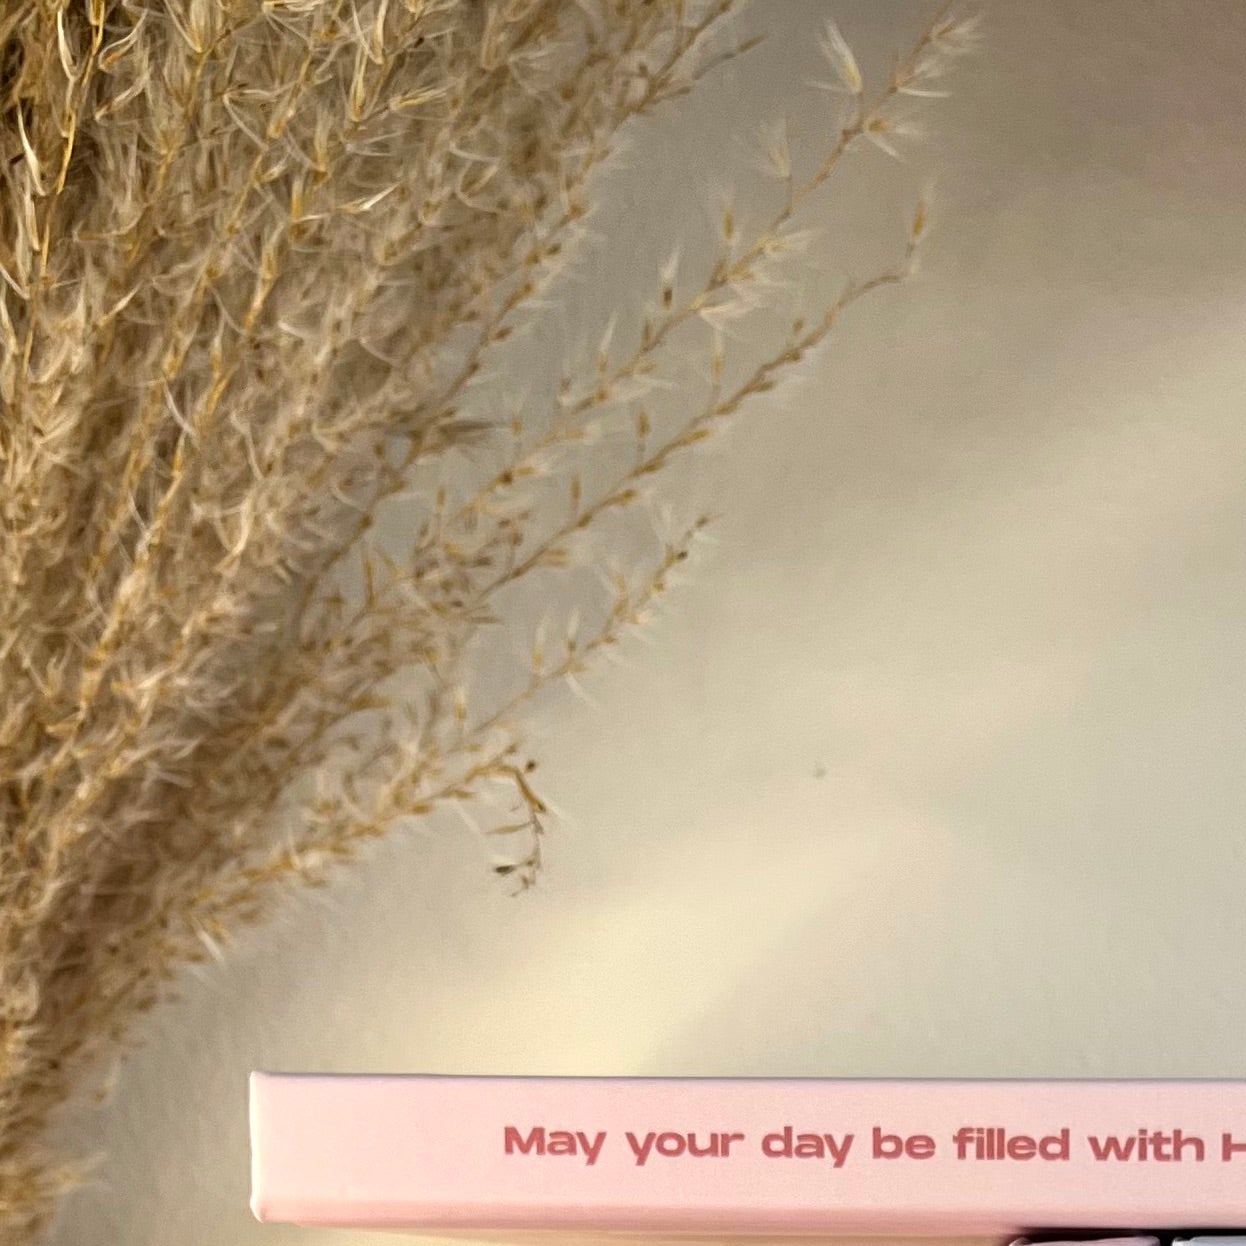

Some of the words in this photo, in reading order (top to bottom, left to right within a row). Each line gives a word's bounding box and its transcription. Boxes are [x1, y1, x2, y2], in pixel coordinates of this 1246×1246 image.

[504, 1126, 607, 1166] May
[625, 1132, 745, 1166] your
[761, 1126, 854, 1168] day
[872, 1126, 936, 1160] be
[953, 1127, 1070, 1161] filled
[1087, 1128, 1205, 1162] with
